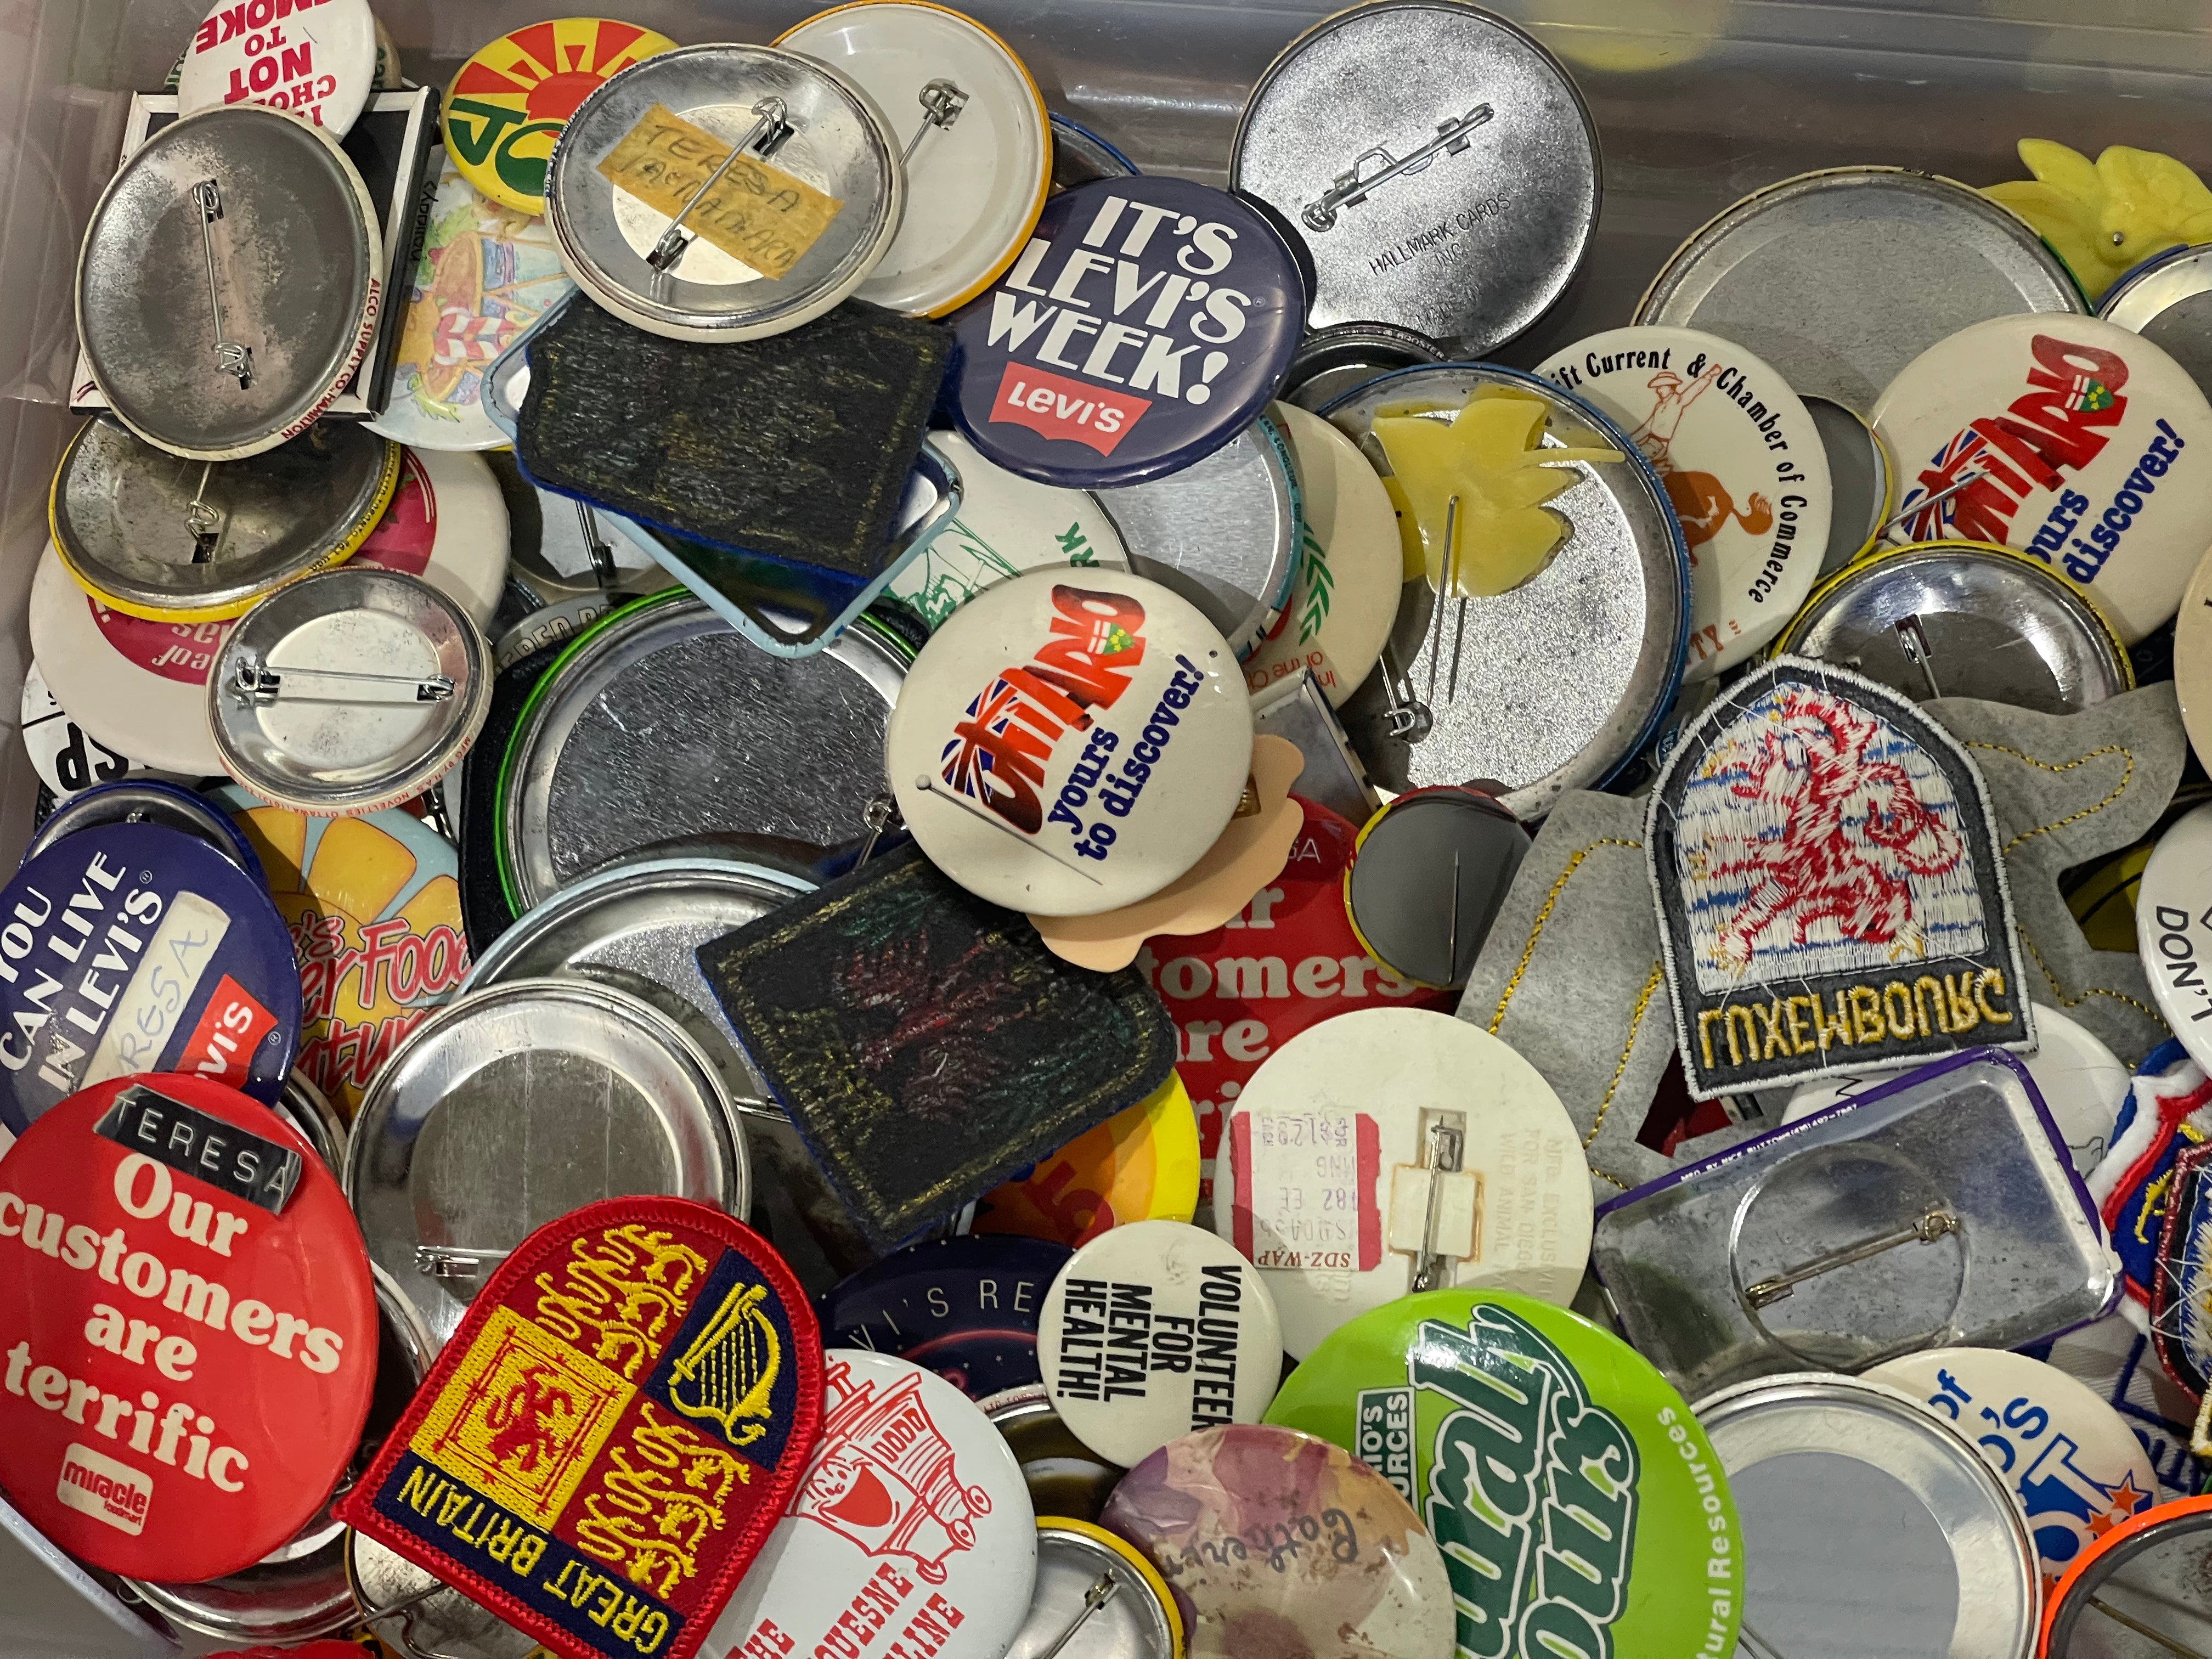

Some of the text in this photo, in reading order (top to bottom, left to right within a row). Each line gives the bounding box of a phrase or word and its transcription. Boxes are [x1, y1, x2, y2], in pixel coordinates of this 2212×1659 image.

[224, 42, 312, 104] NOT
[245, 26, 286, 57] TO
[1082, 196, 1238, 275] IT'S
[1369, 193, 1511, 277] HALLMARK CARDS
[366, 277, 381, 317] ALCO
[1005, 238, 1251, 344] LEVI'S
[348, 322, 373, 372] SUPPLY
[988, 291, 1228, 405] WEEK!
[281, 392, 336, 439] HAMILTON
[1550, 347, 1808, 603] ift Current & Chamber of Commerce
[2062, 418, 2186, 585] discover!
[940, 583, 1147, 835] ONTARIO
[1073, 653, 1205, 861] to discover!
[292, 808, 340, 818] OTTAWA
[345, 792, 410, 816] NOVELTIES
[1047, 726, 1120, 836] yours
[0, 851, 126, 1070] CAN LIVE
[115, 1095, 292, 1198] TERESA
[114, 1154, 248, 1257] Our
[0, 1191, 344, 1374] customers
[1258, 1251, 1351, 1268] SDZ-WAP
[84, 1303, 198, 1381] are
[848, 1279, 1036, 1351] VI'S RE
[1057, 1278, 1108, 1401] HEALTH!
[1103, 1282, 1153, 1403] MENTAL
[1150, 1314, 1195, 1374] FOR
[7, 1340, 249, 1492] terrific
[1385, 1393, 1410, 1499] URCES
[64, 1460, 148, 1513] miracle
[1656, 1406, 1732, 1579] Resources
[398, 1466, 673, 1655] GREAT BRITAIN
